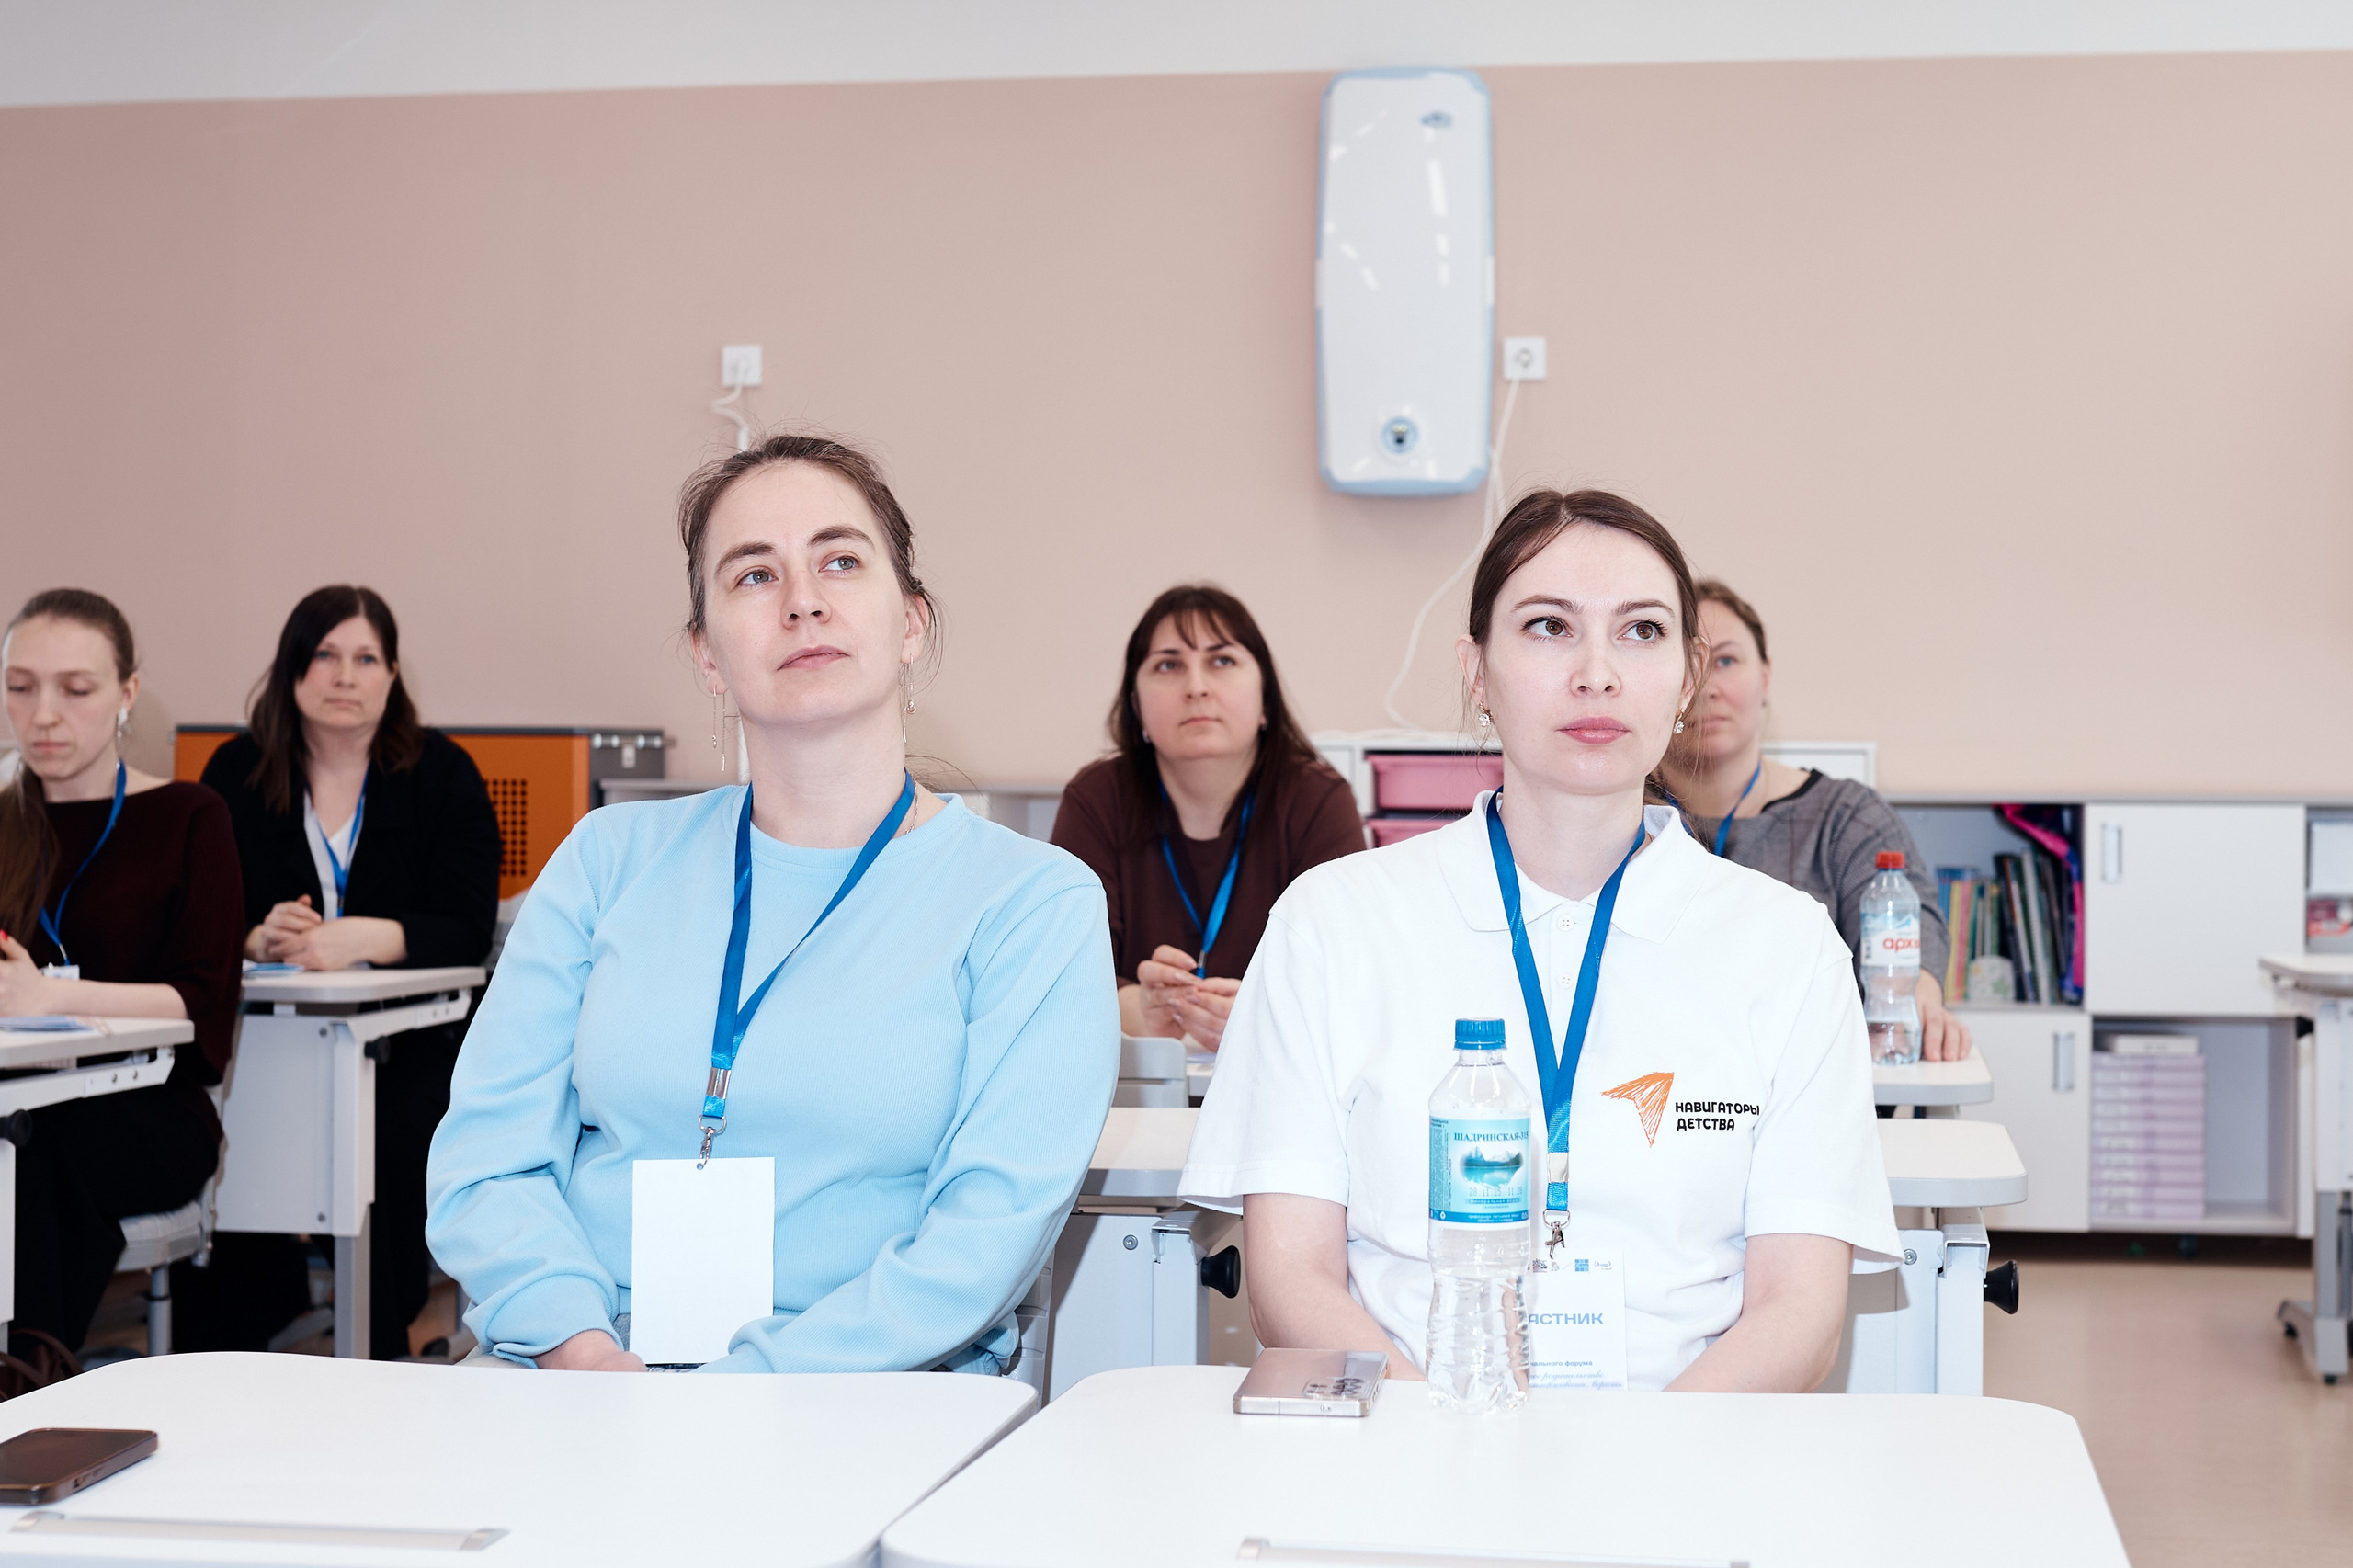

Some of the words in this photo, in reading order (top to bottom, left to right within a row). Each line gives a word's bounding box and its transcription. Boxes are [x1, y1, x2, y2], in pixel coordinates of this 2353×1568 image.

[1675, 1101, 1760, 1116] НАВИГАТОРЫ
[1677, 1118, 1735, 1131] ДЕТСТВА
[1528, 1312, 1604, 1324] АСТНИК
